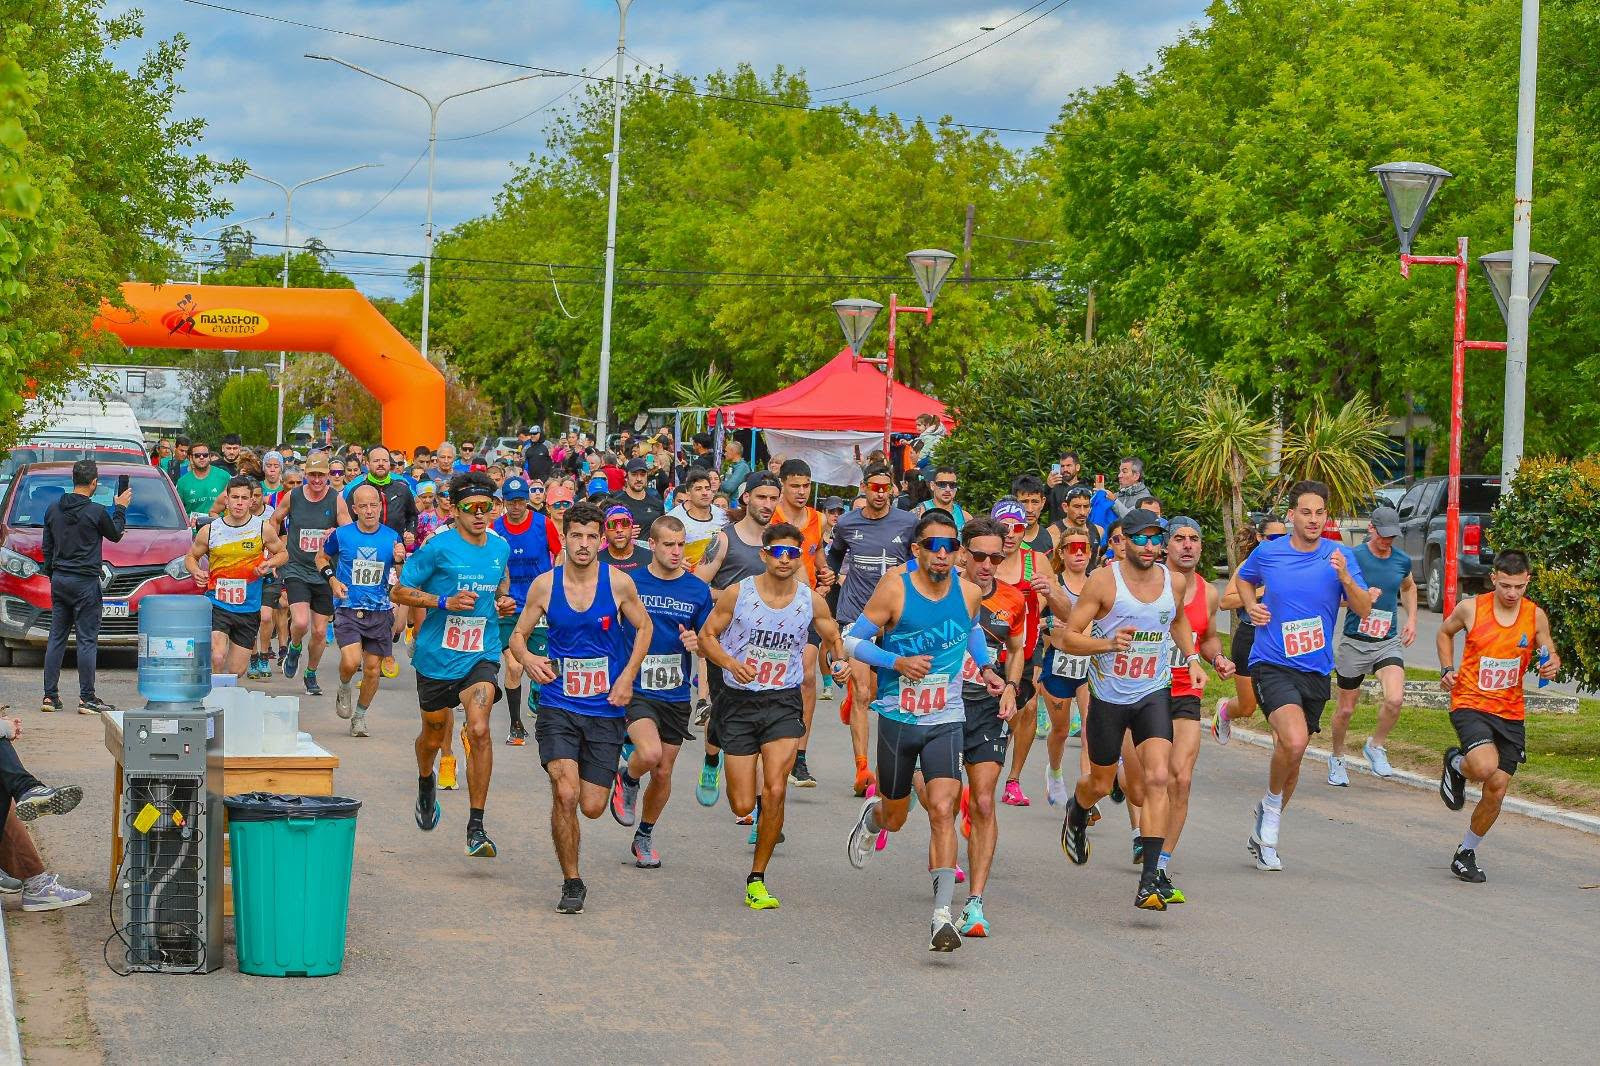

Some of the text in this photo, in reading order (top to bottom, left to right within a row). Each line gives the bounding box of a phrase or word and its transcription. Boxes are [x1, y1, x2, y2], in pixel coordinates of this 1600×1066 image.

[200, 314, 260, 325] MARATHON
[212, 323, 256, 334] eventos
[353, 568, 382, 585] 184
[456, 581, 470, 591] La
[217, 587, 245, 604] 613
[446, 626, 482, 651] 612
[1285, 627, 1325, 656] 655
[643, 666, 682, 689] 194
[745, 657, 788, 687] 582
[1056, 655, 1087, 678] 211
[1113, 653, 1157, 679] 584
[566, 670, 607, 696] 579
[1480, 667, 1518, 689] 629
[901, 687, 946, 714] 644
